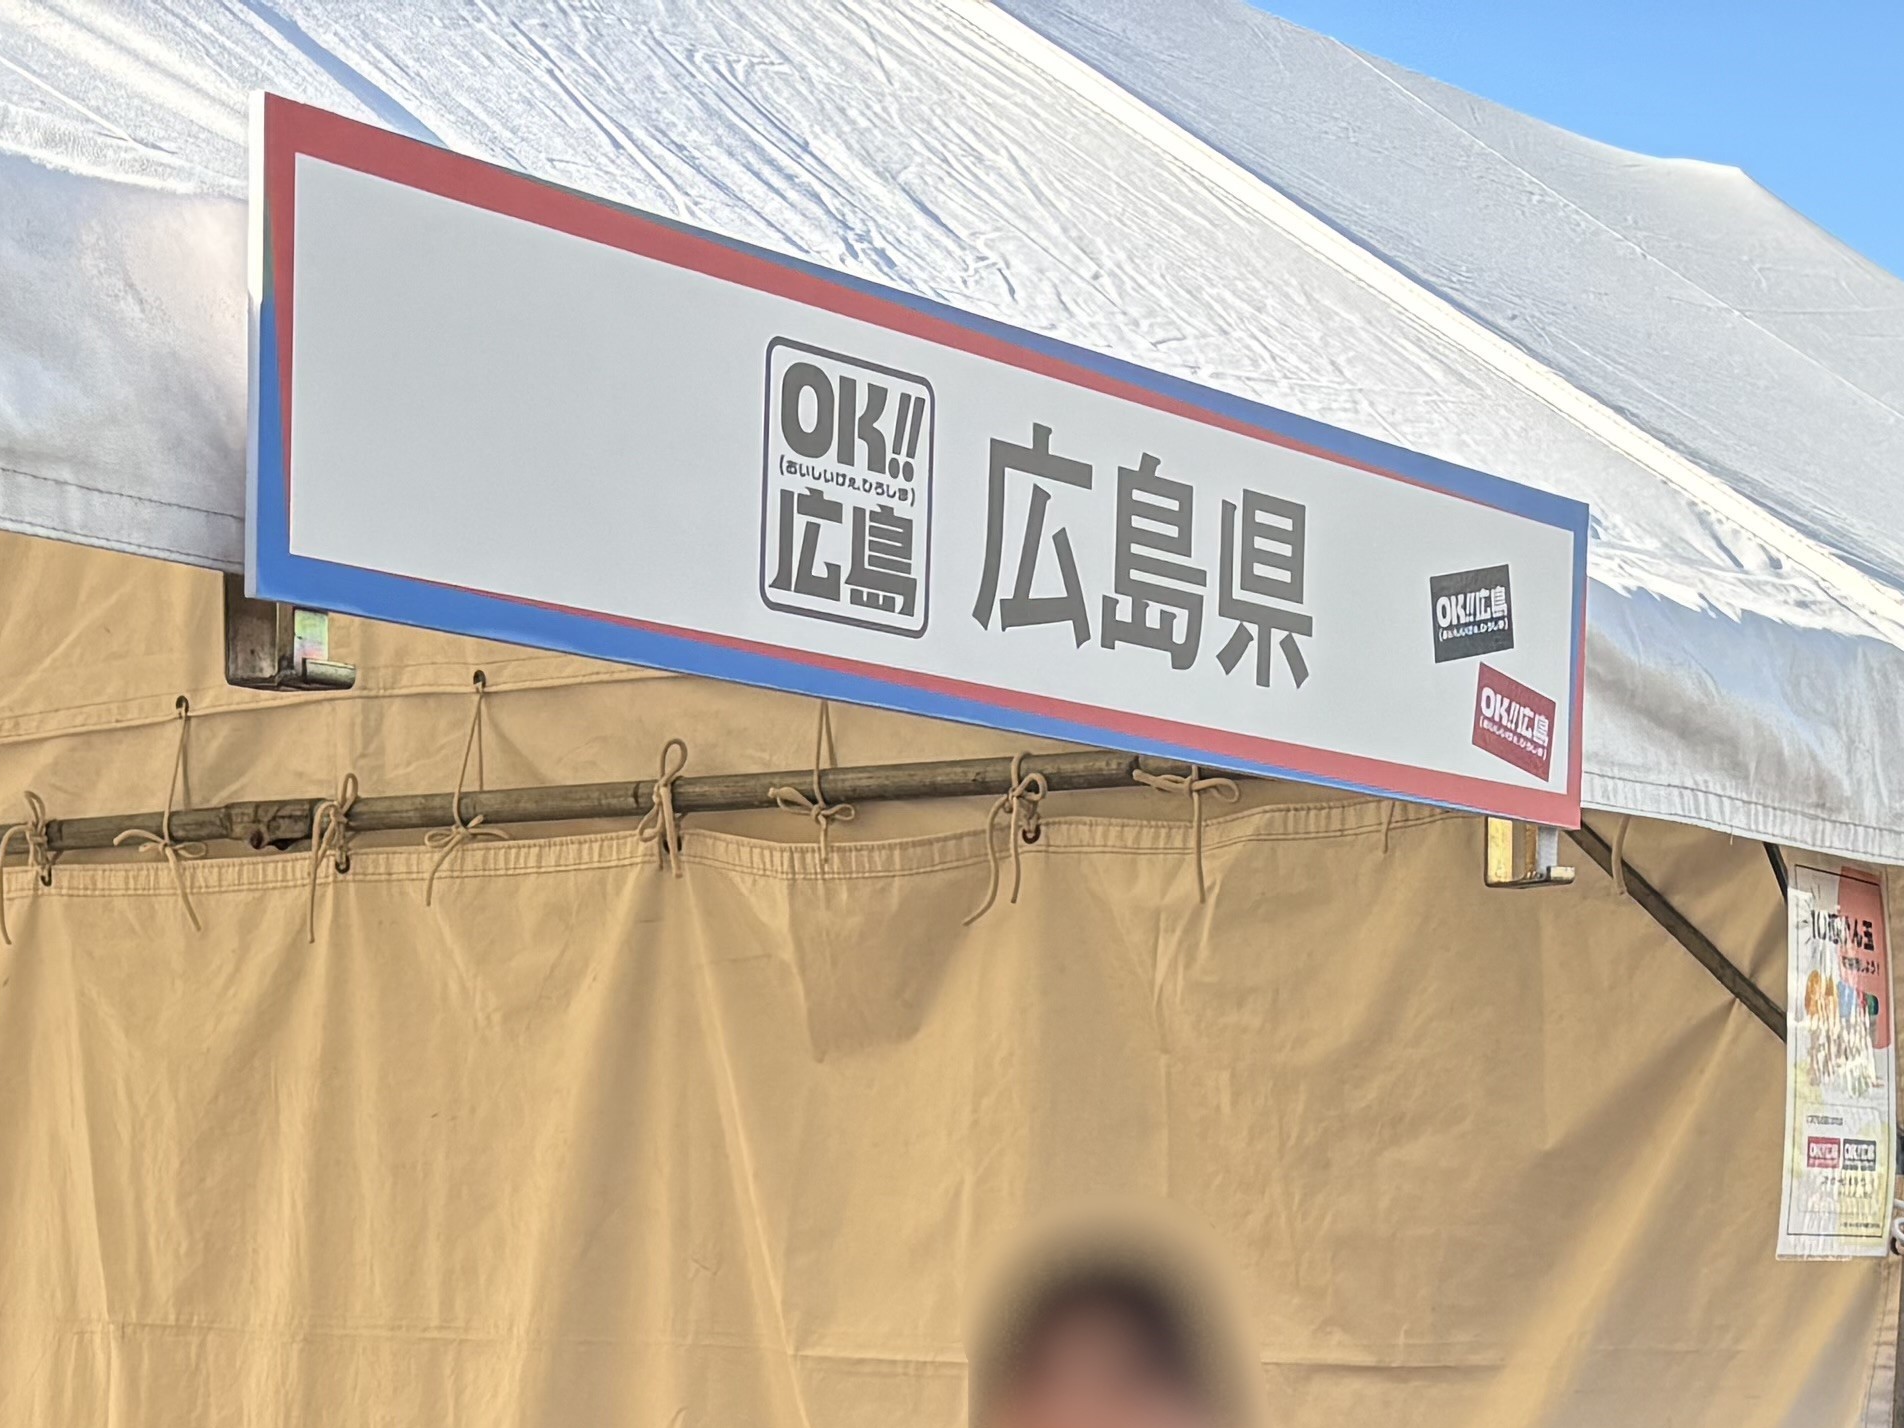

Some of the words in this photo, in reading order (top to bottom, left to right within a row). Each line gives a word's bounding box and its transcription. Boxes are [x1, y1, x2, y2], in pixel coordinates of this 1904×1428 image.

[781, 362, 926, 482] OK!!
[768, 487, 917, 617] 広島
[972, 422, 1313, 689] 広島県
[1436, 585, 1507, 628] OK!!広島
[1481, 687, 1549, 747] OK!!広島
